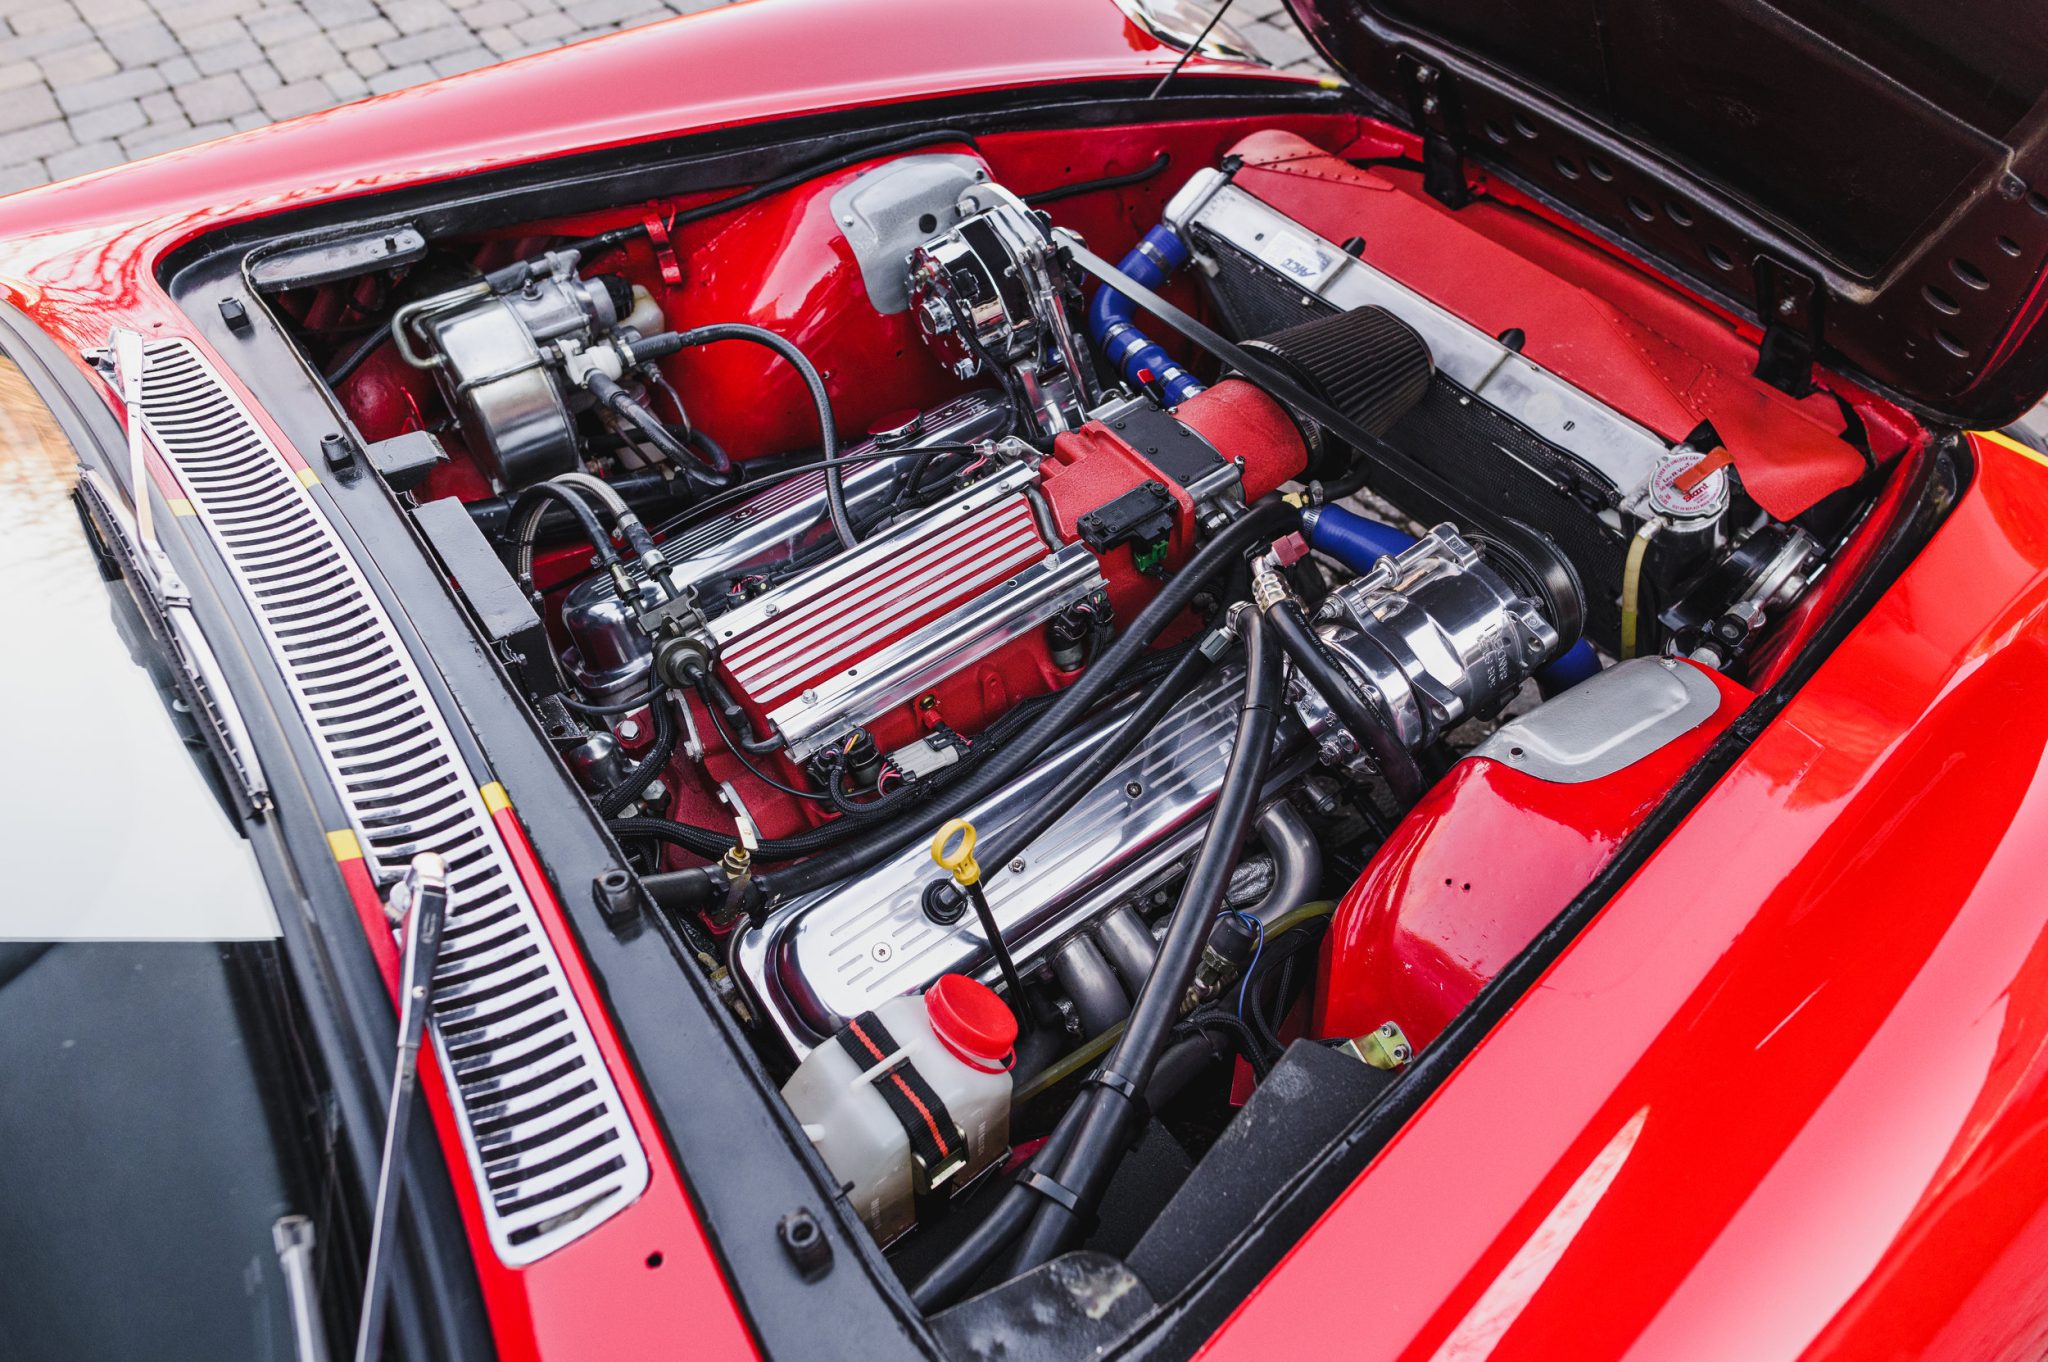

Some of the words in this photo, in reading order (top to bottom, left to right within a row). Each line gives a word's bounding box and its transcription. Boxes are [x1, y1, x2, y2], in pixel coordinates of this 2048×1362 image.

[1657, 467, 1665, 479] LEVER
[1670, 456, 1688, 464] UNLOCK
[1683, 483, 1708, 502] Stant
